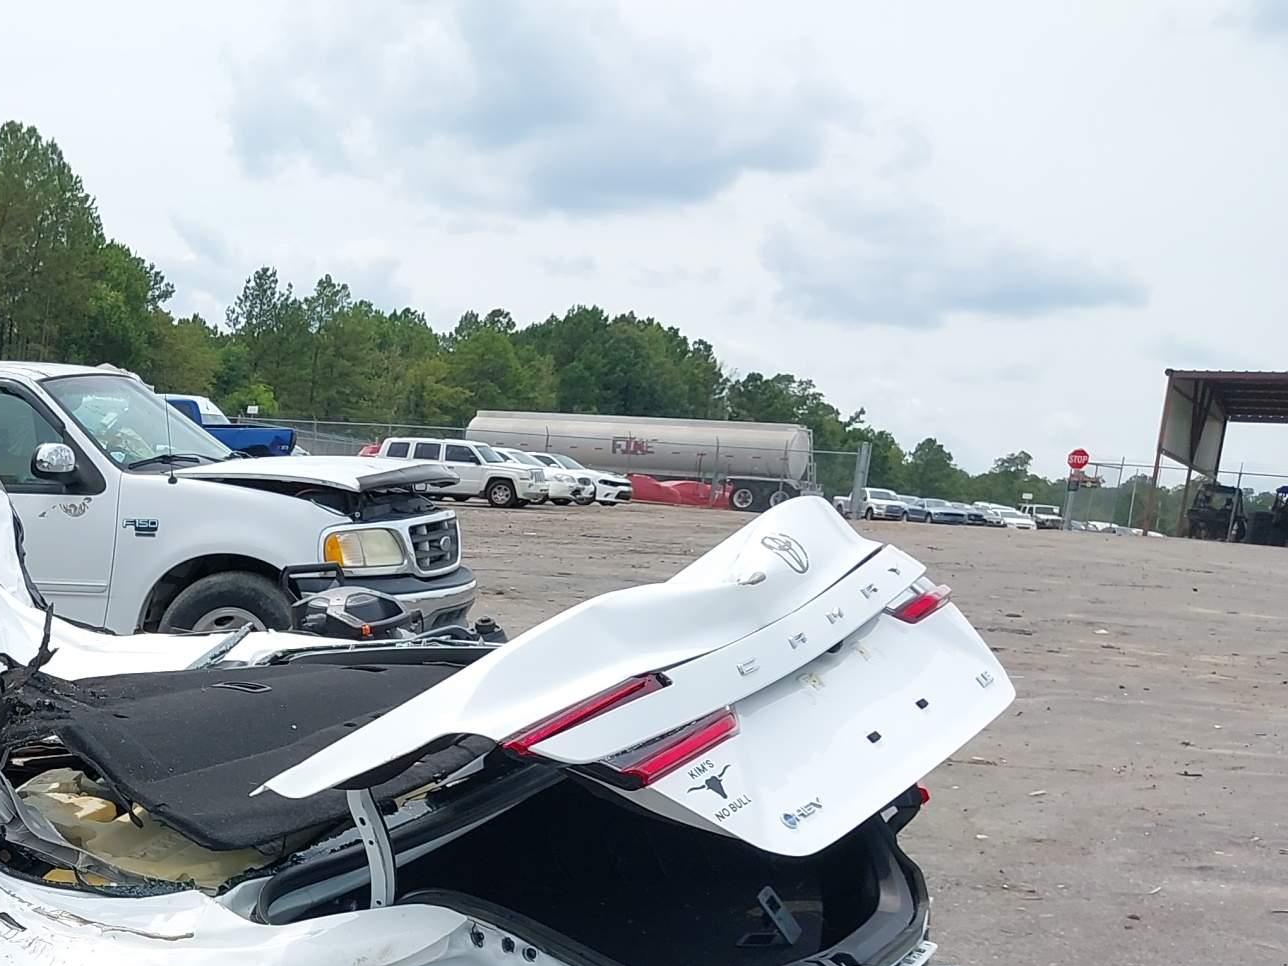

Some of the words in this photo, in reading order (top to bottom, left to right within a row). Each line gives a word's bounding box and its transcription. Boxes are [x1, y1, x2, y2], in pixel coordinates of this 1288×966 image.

[1069, 455, 1088, 464] STOP
[687, 759, 715, 780] KIM'S
[714, 805, 731, 822] NO
[729, 794, 753, 814] BULL
